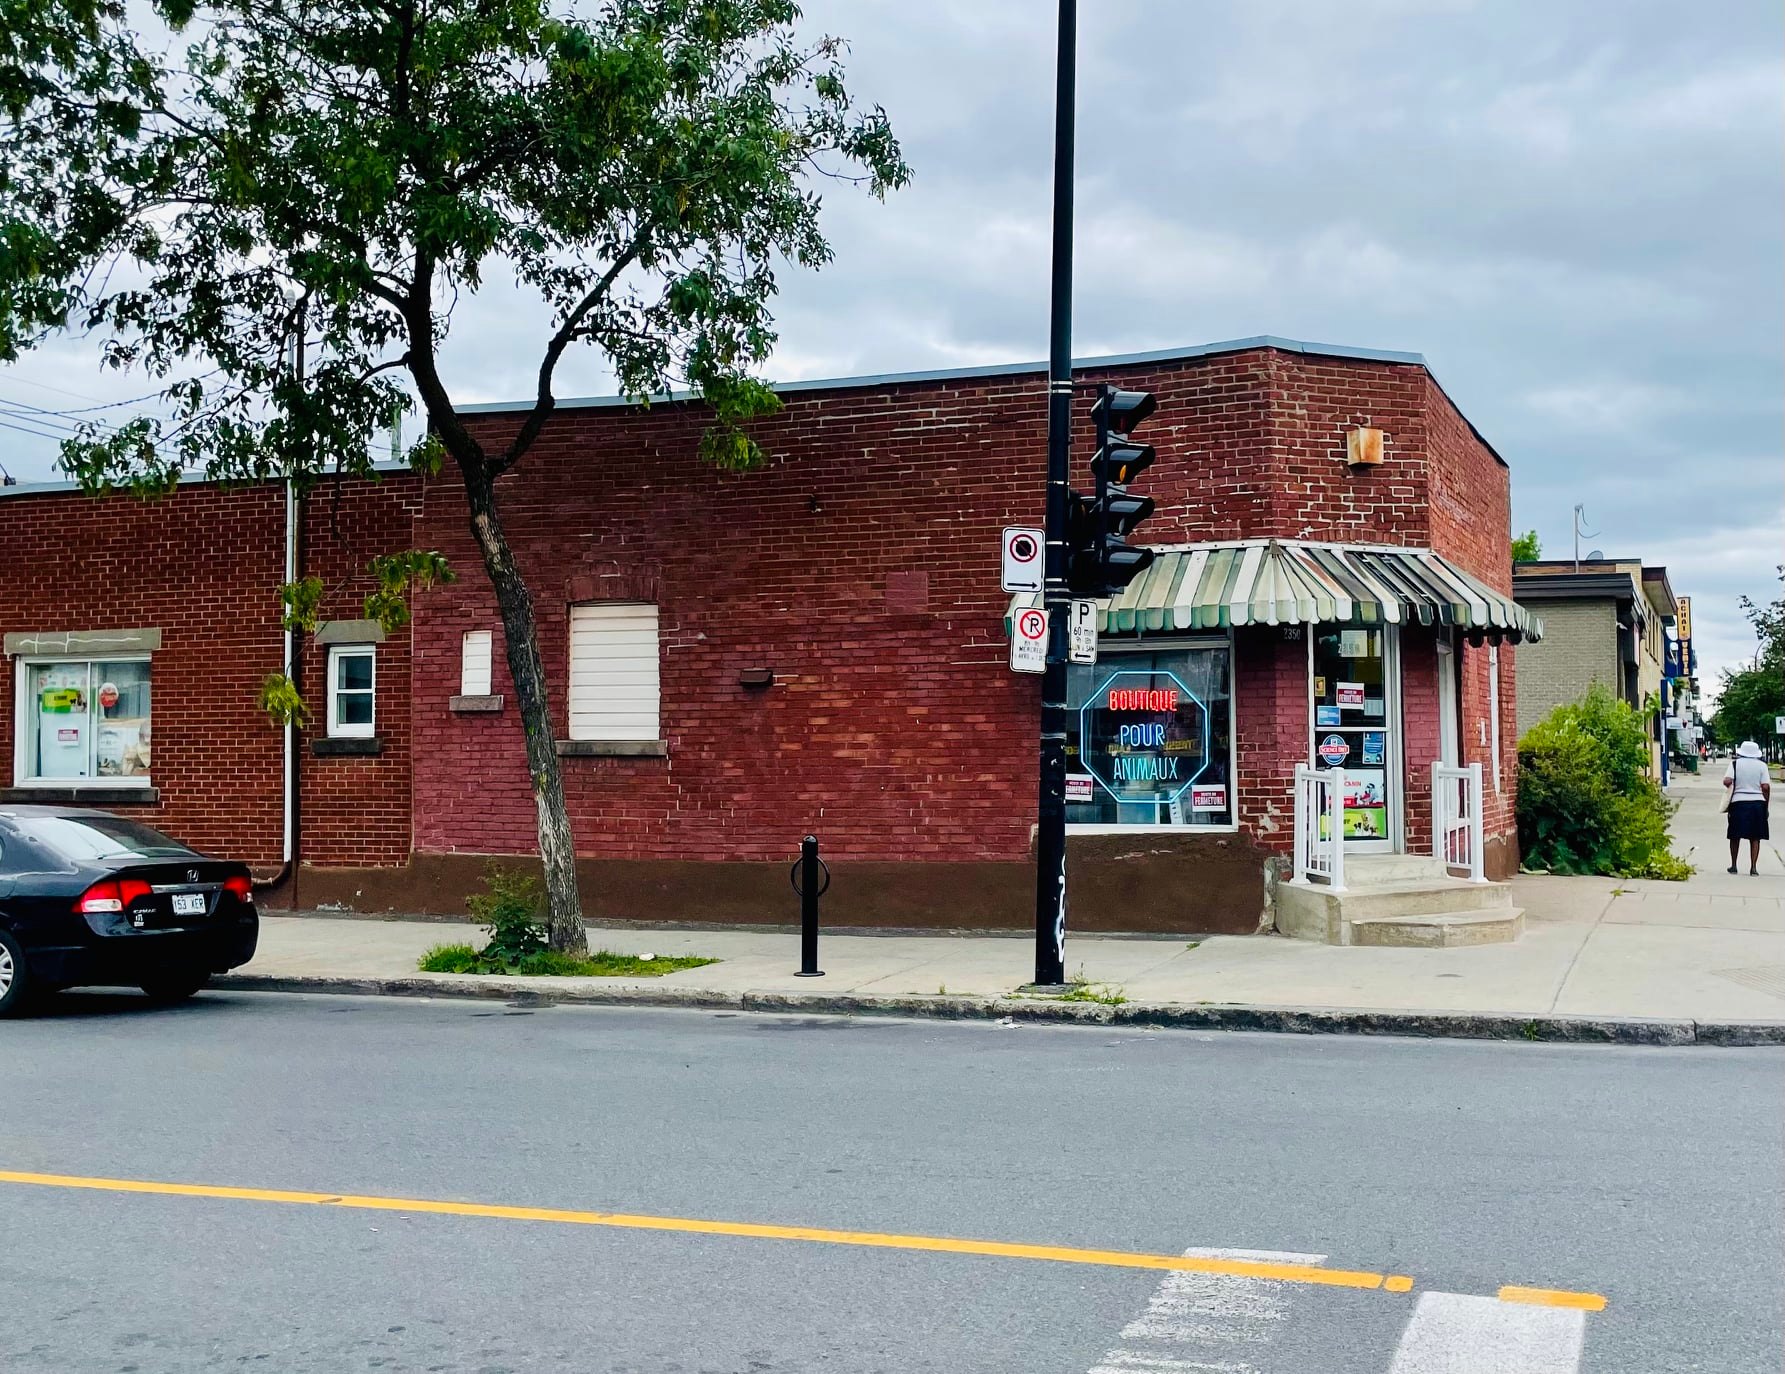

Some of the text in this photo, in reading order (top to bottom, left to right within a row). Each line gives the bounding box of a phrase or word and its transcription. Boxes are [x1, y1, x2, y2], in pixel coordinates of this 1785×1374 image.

[1079, 603, 1089, 624] P
[1073, 626, 1082, 636] 60
[1110, 690, 1177, 712] BOUTIQUE
[1120, 724, 1165, 746] POUR
[1114, 757, 1178, 780] ANIMAUX
[1194, 796, 1224, 806] FERMETURE
